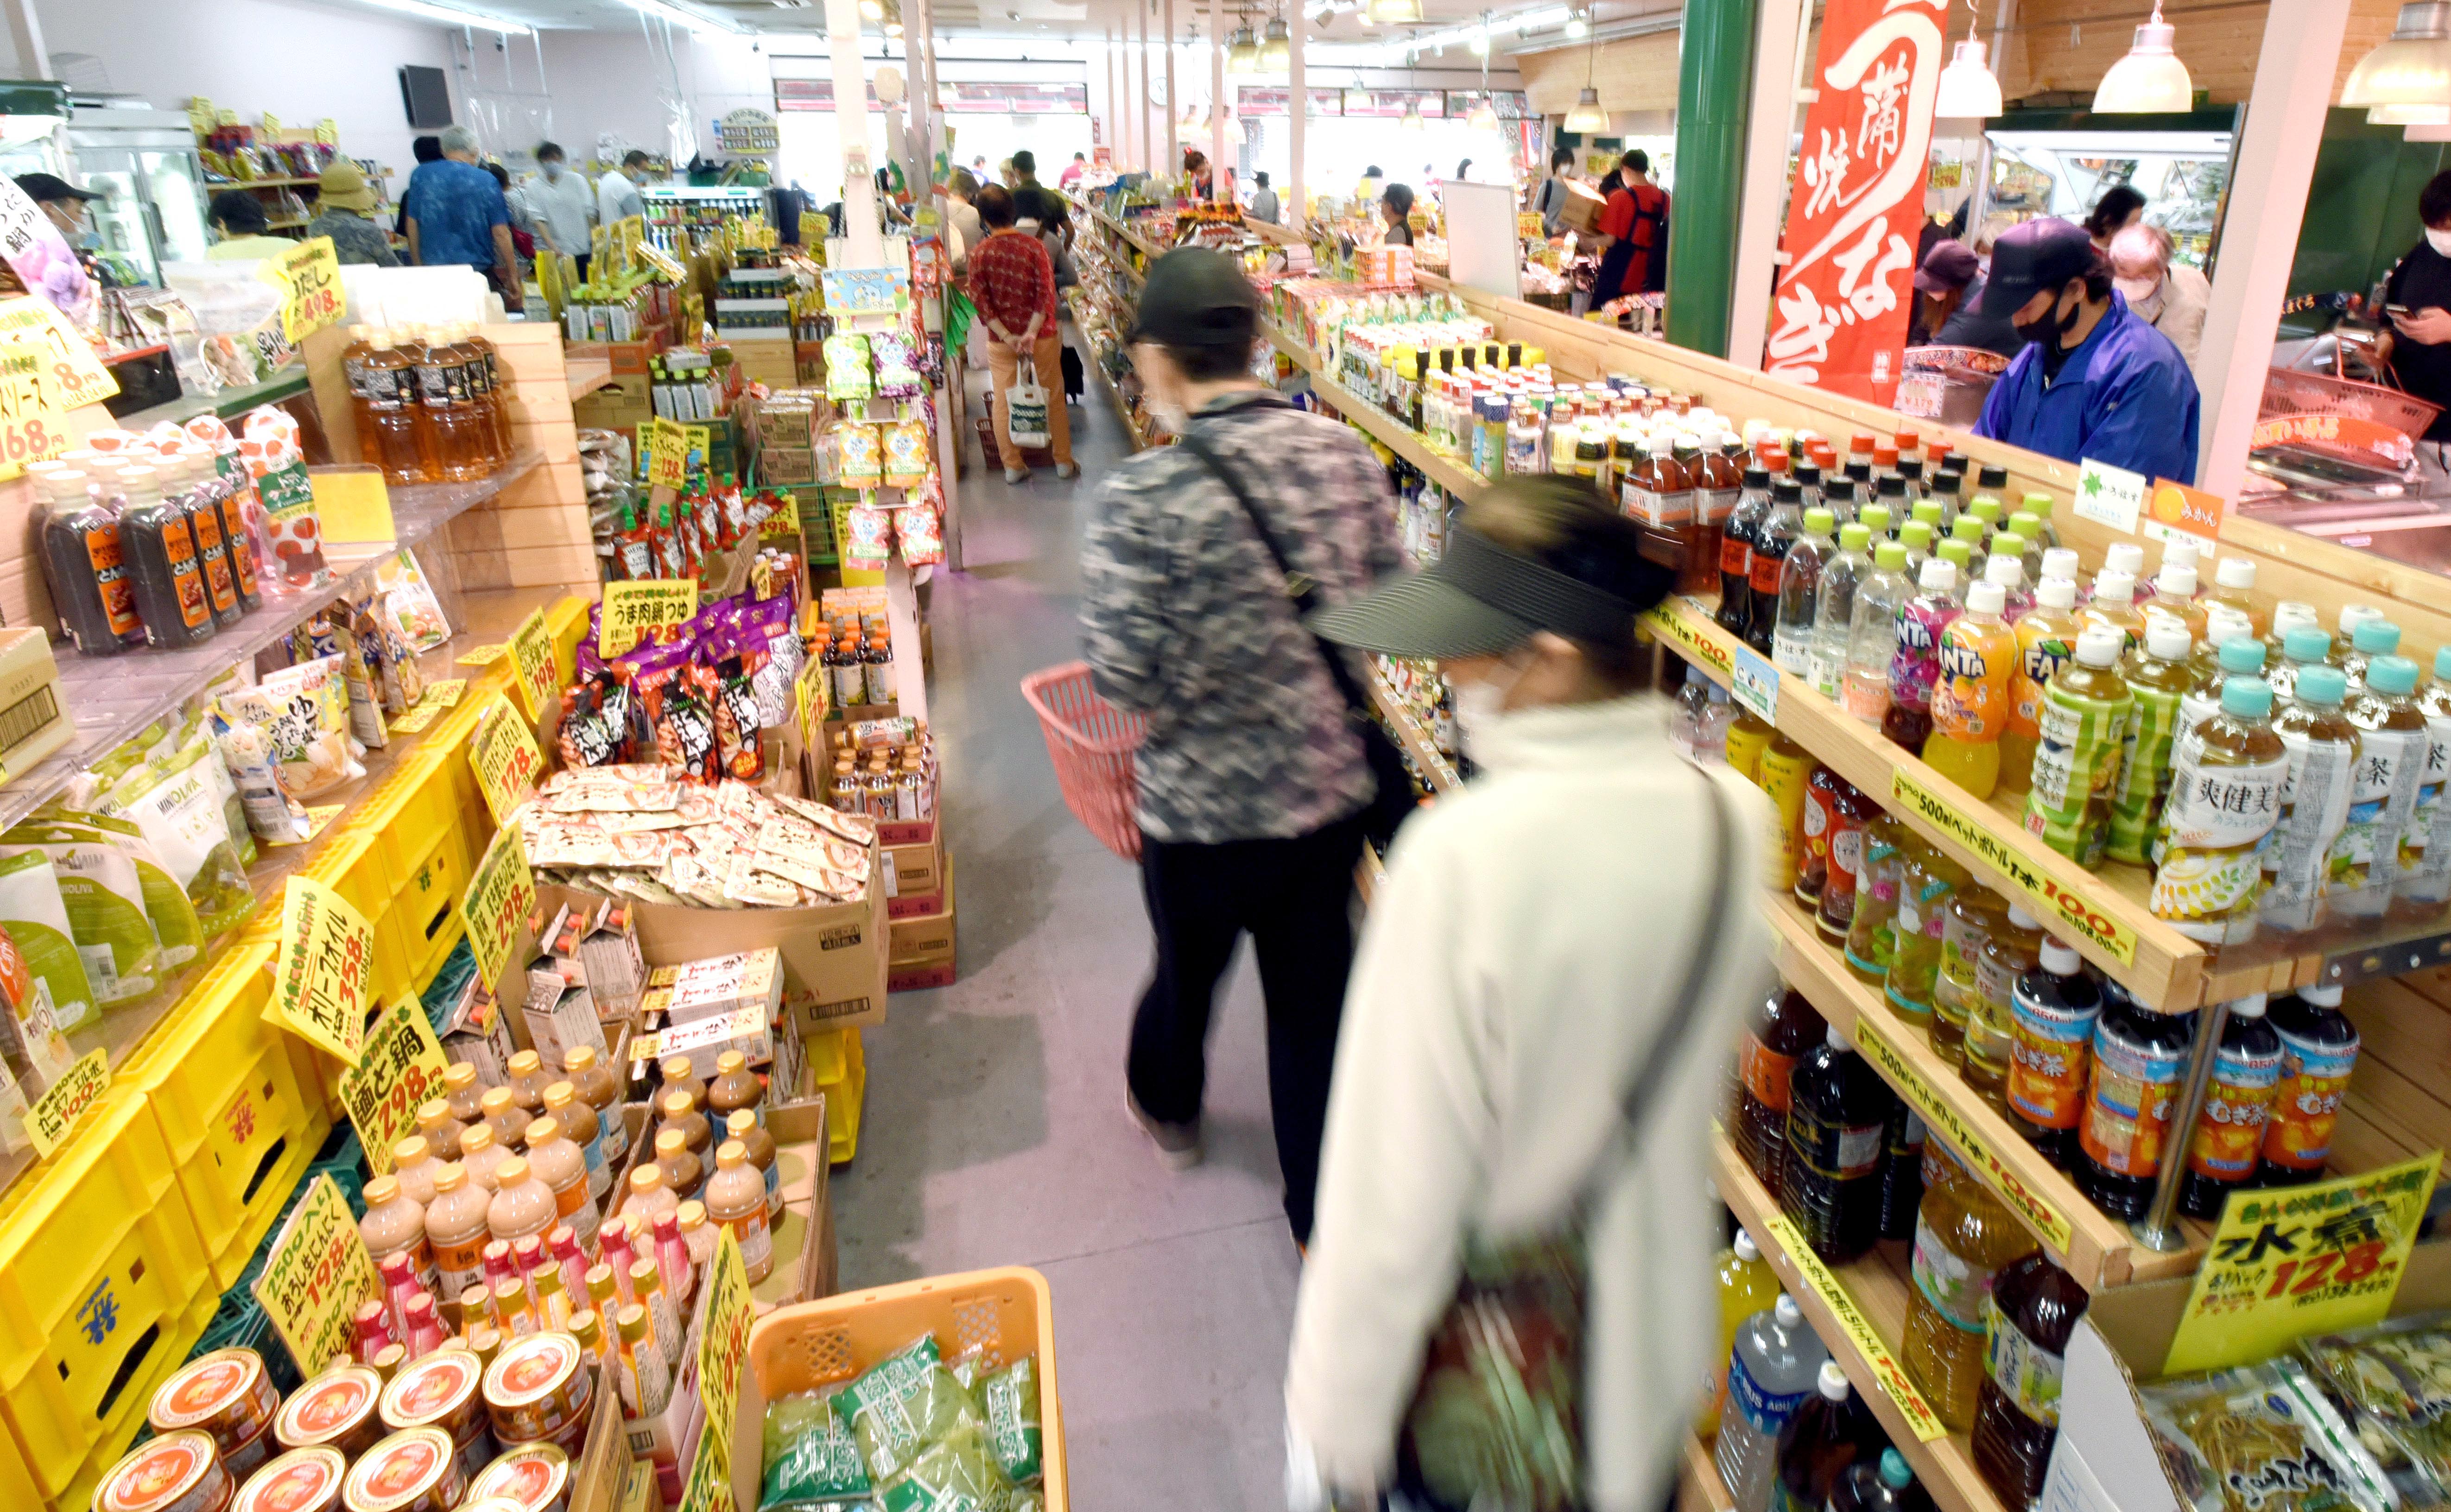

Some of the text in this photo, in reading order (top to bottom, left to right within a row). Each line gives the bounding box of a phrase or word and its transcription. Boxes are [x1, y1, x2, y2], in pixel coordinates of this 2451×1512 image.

[2181, 501, 2217, 527] みかん
[308, 907, 348, 1031] オリーブオイル
[350, 1024, 426, 1133] 麺と鍋
[280, 1202, 342, 1316] おろし生にんにく
